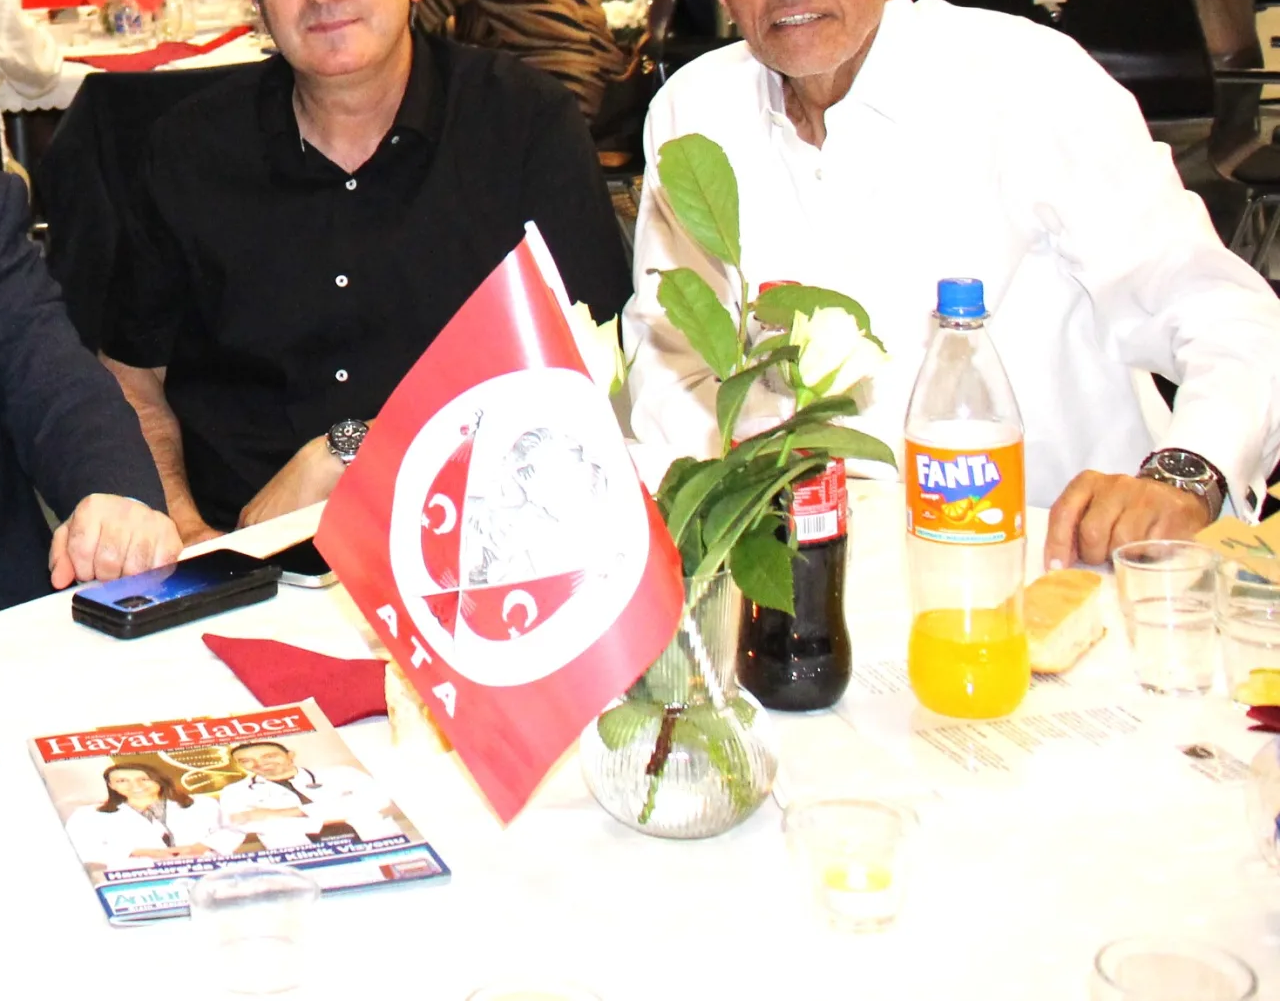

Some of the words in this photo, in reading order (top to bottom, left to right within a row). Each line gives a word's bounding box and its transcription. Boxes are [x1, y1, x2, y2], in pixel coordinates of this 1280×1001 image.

[916, 454, 1001, 489] FANTA
[376, 604, 457, 719] ATA
[46, 731, 169, 754] Hayat
[172, 715, 300, 743] Haber
[286, 846, 336, 863] Klinik
[336, 836, 406, 854] Vizyonu
